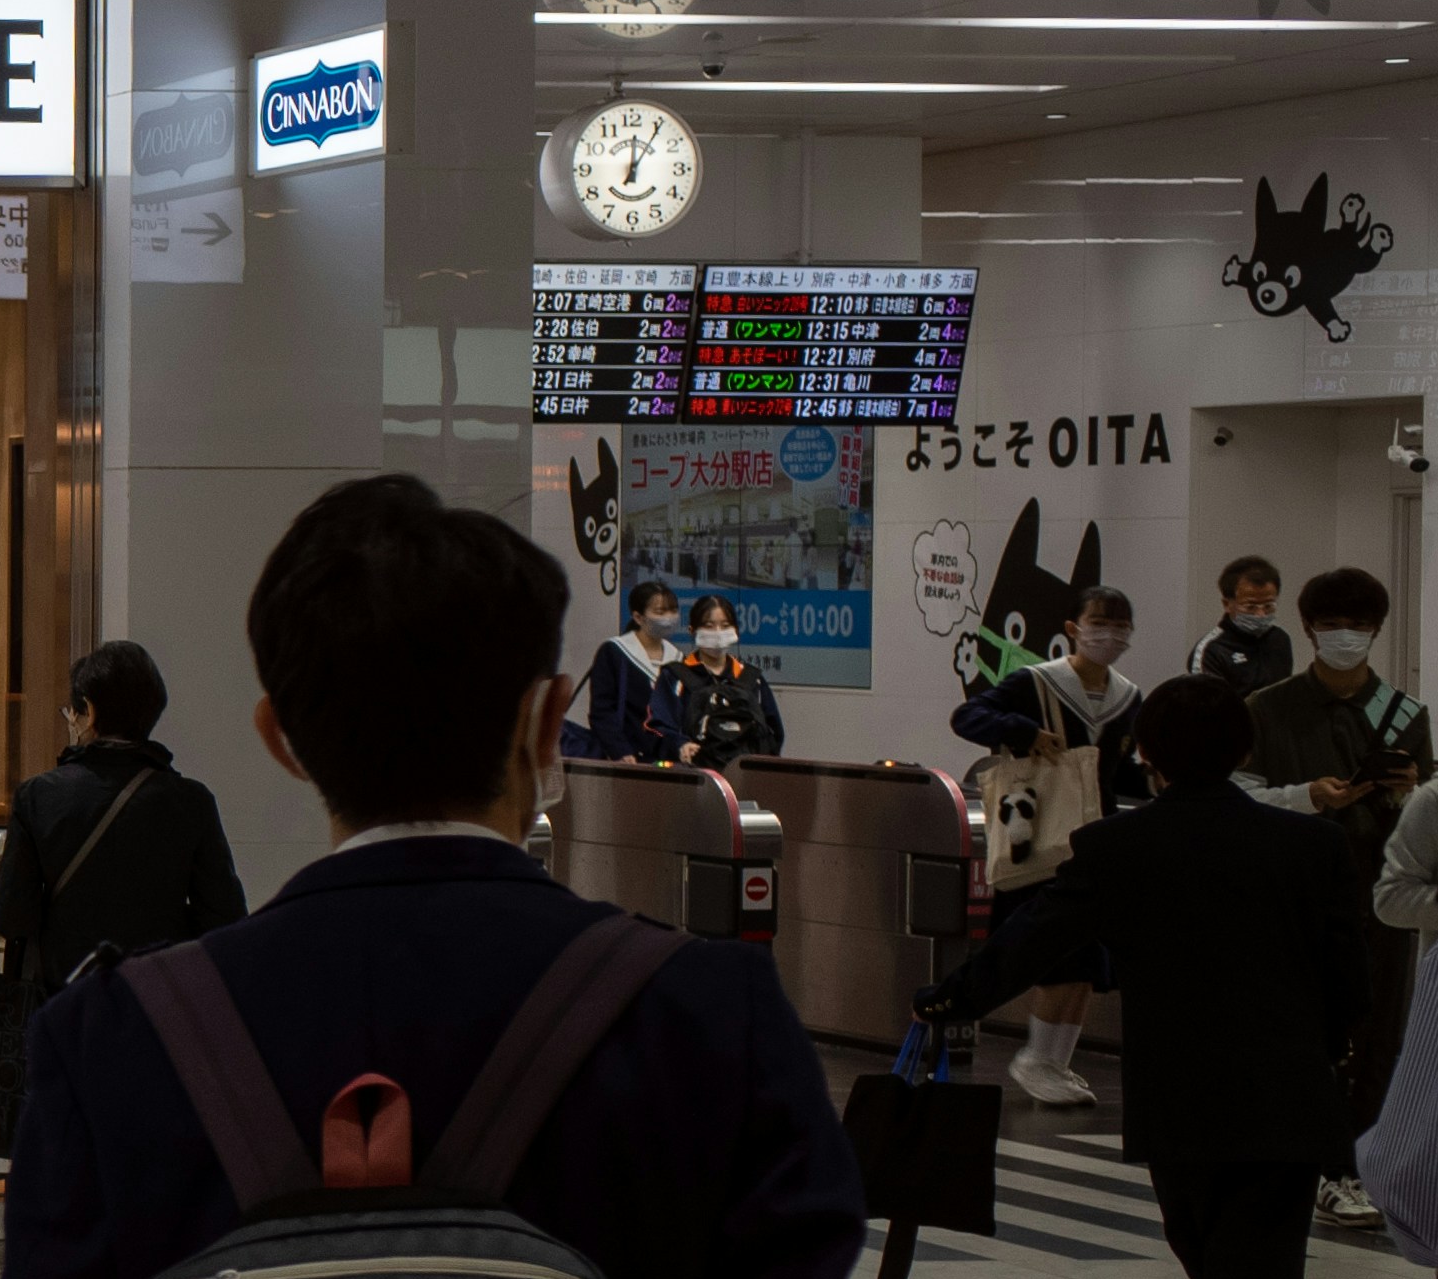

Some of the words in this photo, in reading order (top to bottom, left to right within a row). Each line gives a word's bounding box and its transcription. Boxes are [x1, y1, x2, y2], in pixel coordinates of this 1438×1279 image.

[268, 76, 375, 132] CINNABON
[622, 114, 642, 127] 12
[601, 124, 618, 138] 11
[586, 142, 605, 156] 10
[666, 138, 679, 153] 2
[579, 163, 592, 177] 9
[673, 162, 686, 176] 3
[585, 185, 599, 200] 8
[666, 185, 678, 199] 4
[603, 205, 615, 219] 7
[626, 211, 639, 225] 6
[649, 205, 662, 218] 5
[669, 269, 693, 285] 方面
[948, 273, 973, 290] 方面
[575, 293, 631, 311] 宮崎空港
[706, 295, 733, 312] 特急
[811, 297, 853, 315] 12:10
[571, 319, 599, 337] 佐伯
[702, 320, 728, 339] 普通
[735, 321, 802, 339] (ワンマン)
[807, 322, 849, 340] 12:15
[851, 323, 880, 340] 中津
[698, 346, 724, 364] 特急
[803, 348, 844, 365] 12:21
[846, 348, 876, 365] 別府
[694, 372, 720, 390] 普通
[727, 373, 794, 390] (ワンマン)
[798, 373, 840, 391] 12:31
[690, 399, 717, 415] 特急
[795, 399, 836, 417] 12:45
[906, 422, 1033, 471] ようこそ
[1048, 413, 1171, 468] OITA
[631, 451, 773, 489] コープ大分駅店
[790, 603, 853, 637] 10:00
